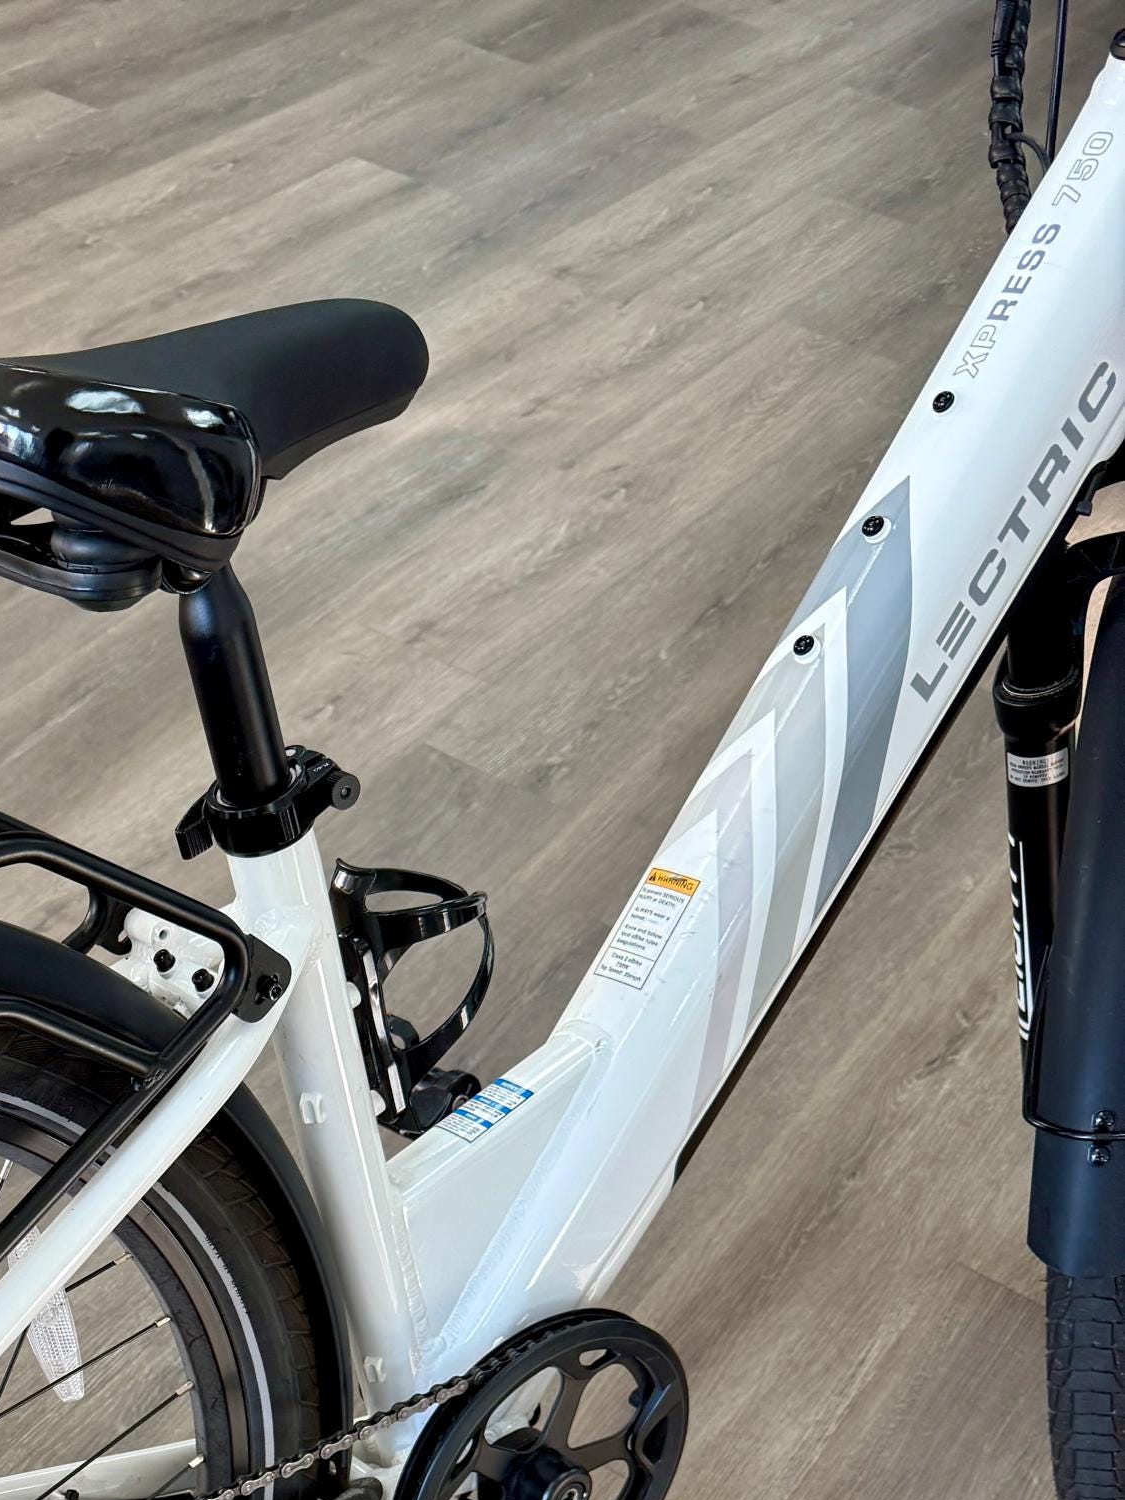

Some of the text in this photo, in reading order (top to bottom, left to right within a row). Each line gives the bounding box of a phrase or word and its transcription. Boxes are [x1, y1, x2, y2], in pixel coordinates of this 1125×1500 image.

[953, 131, 1114, 379] XPRESS 750
[910, 361, 1117, 703] LECTRIC
